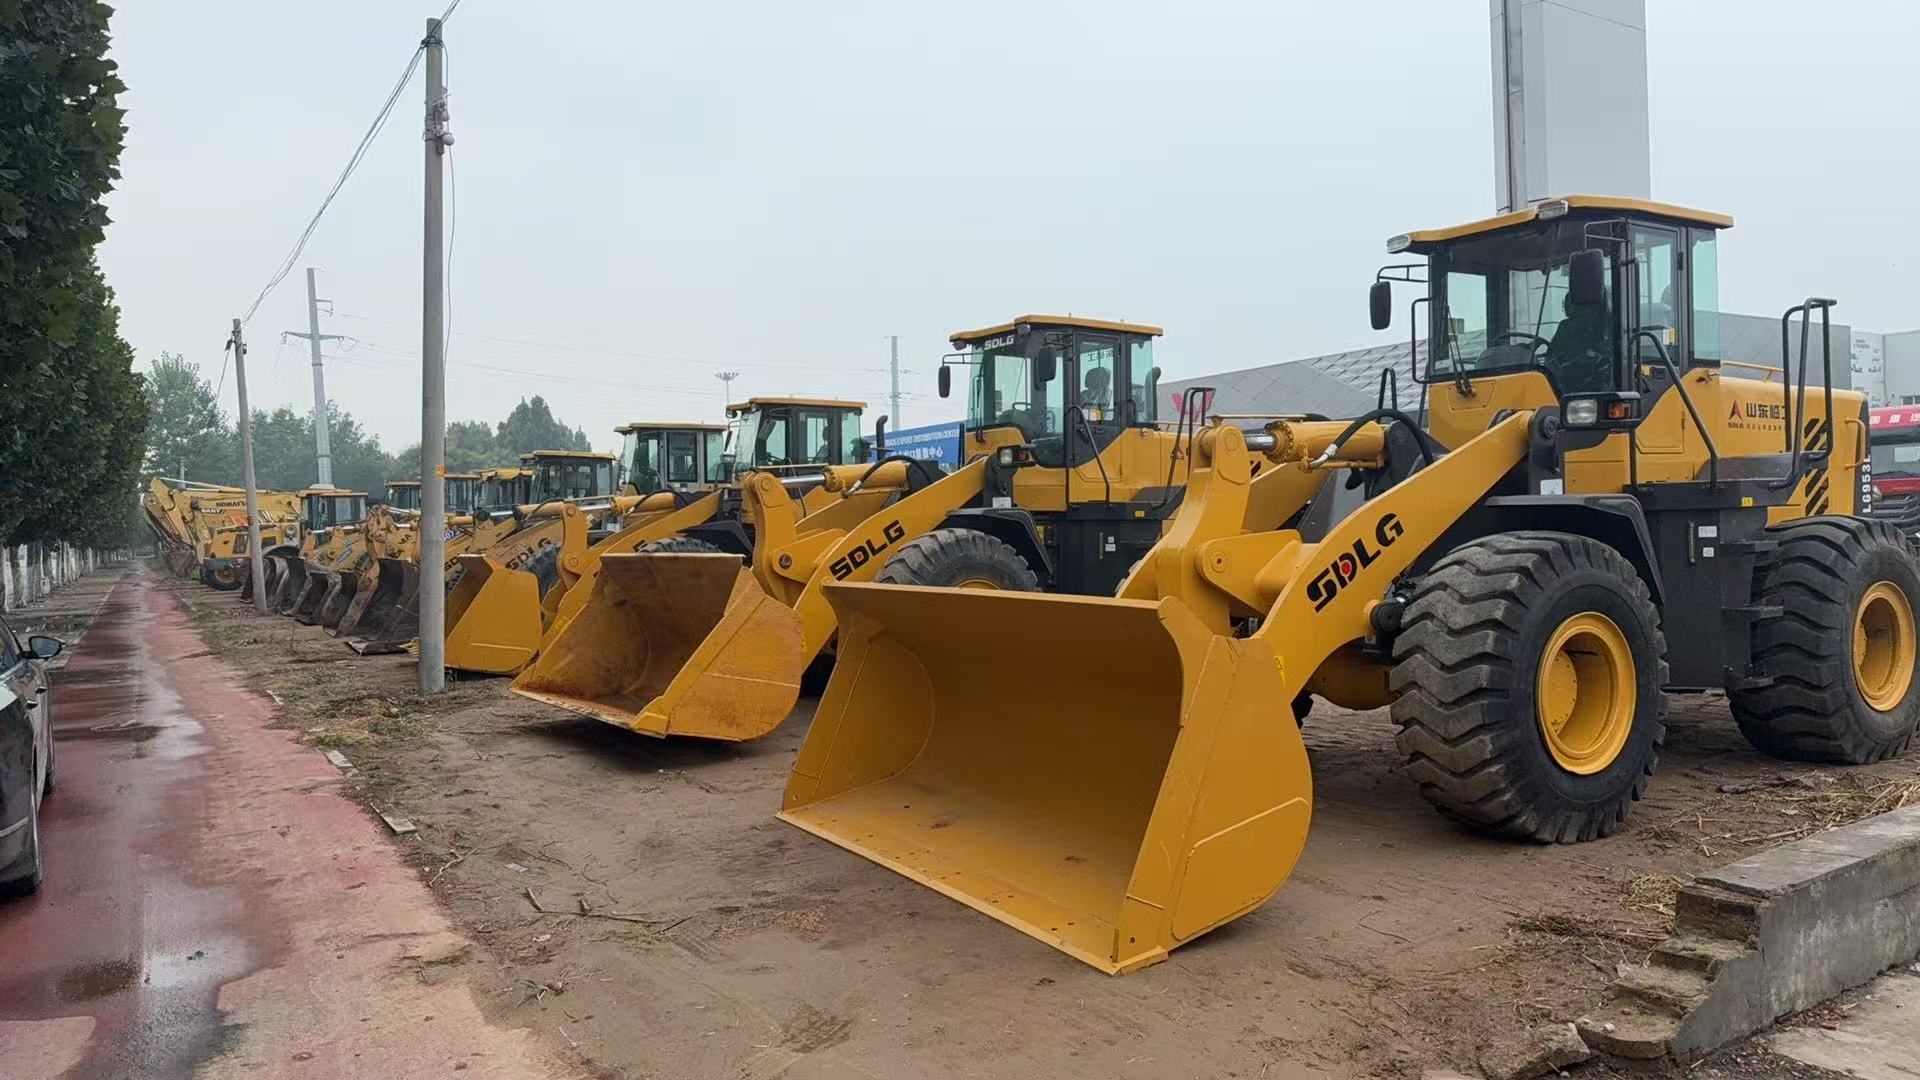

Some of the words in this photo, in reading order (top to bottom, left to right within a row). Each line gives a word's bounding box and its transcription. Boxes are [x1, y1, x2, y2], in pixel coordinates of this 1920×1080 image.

[984, 335, 1015, 350] SDLG
[1862, 454, 1871, 513] LG953L
[829, 520, 905, 581] SDLG
[1306, 513, 1404, 613] SDLG
